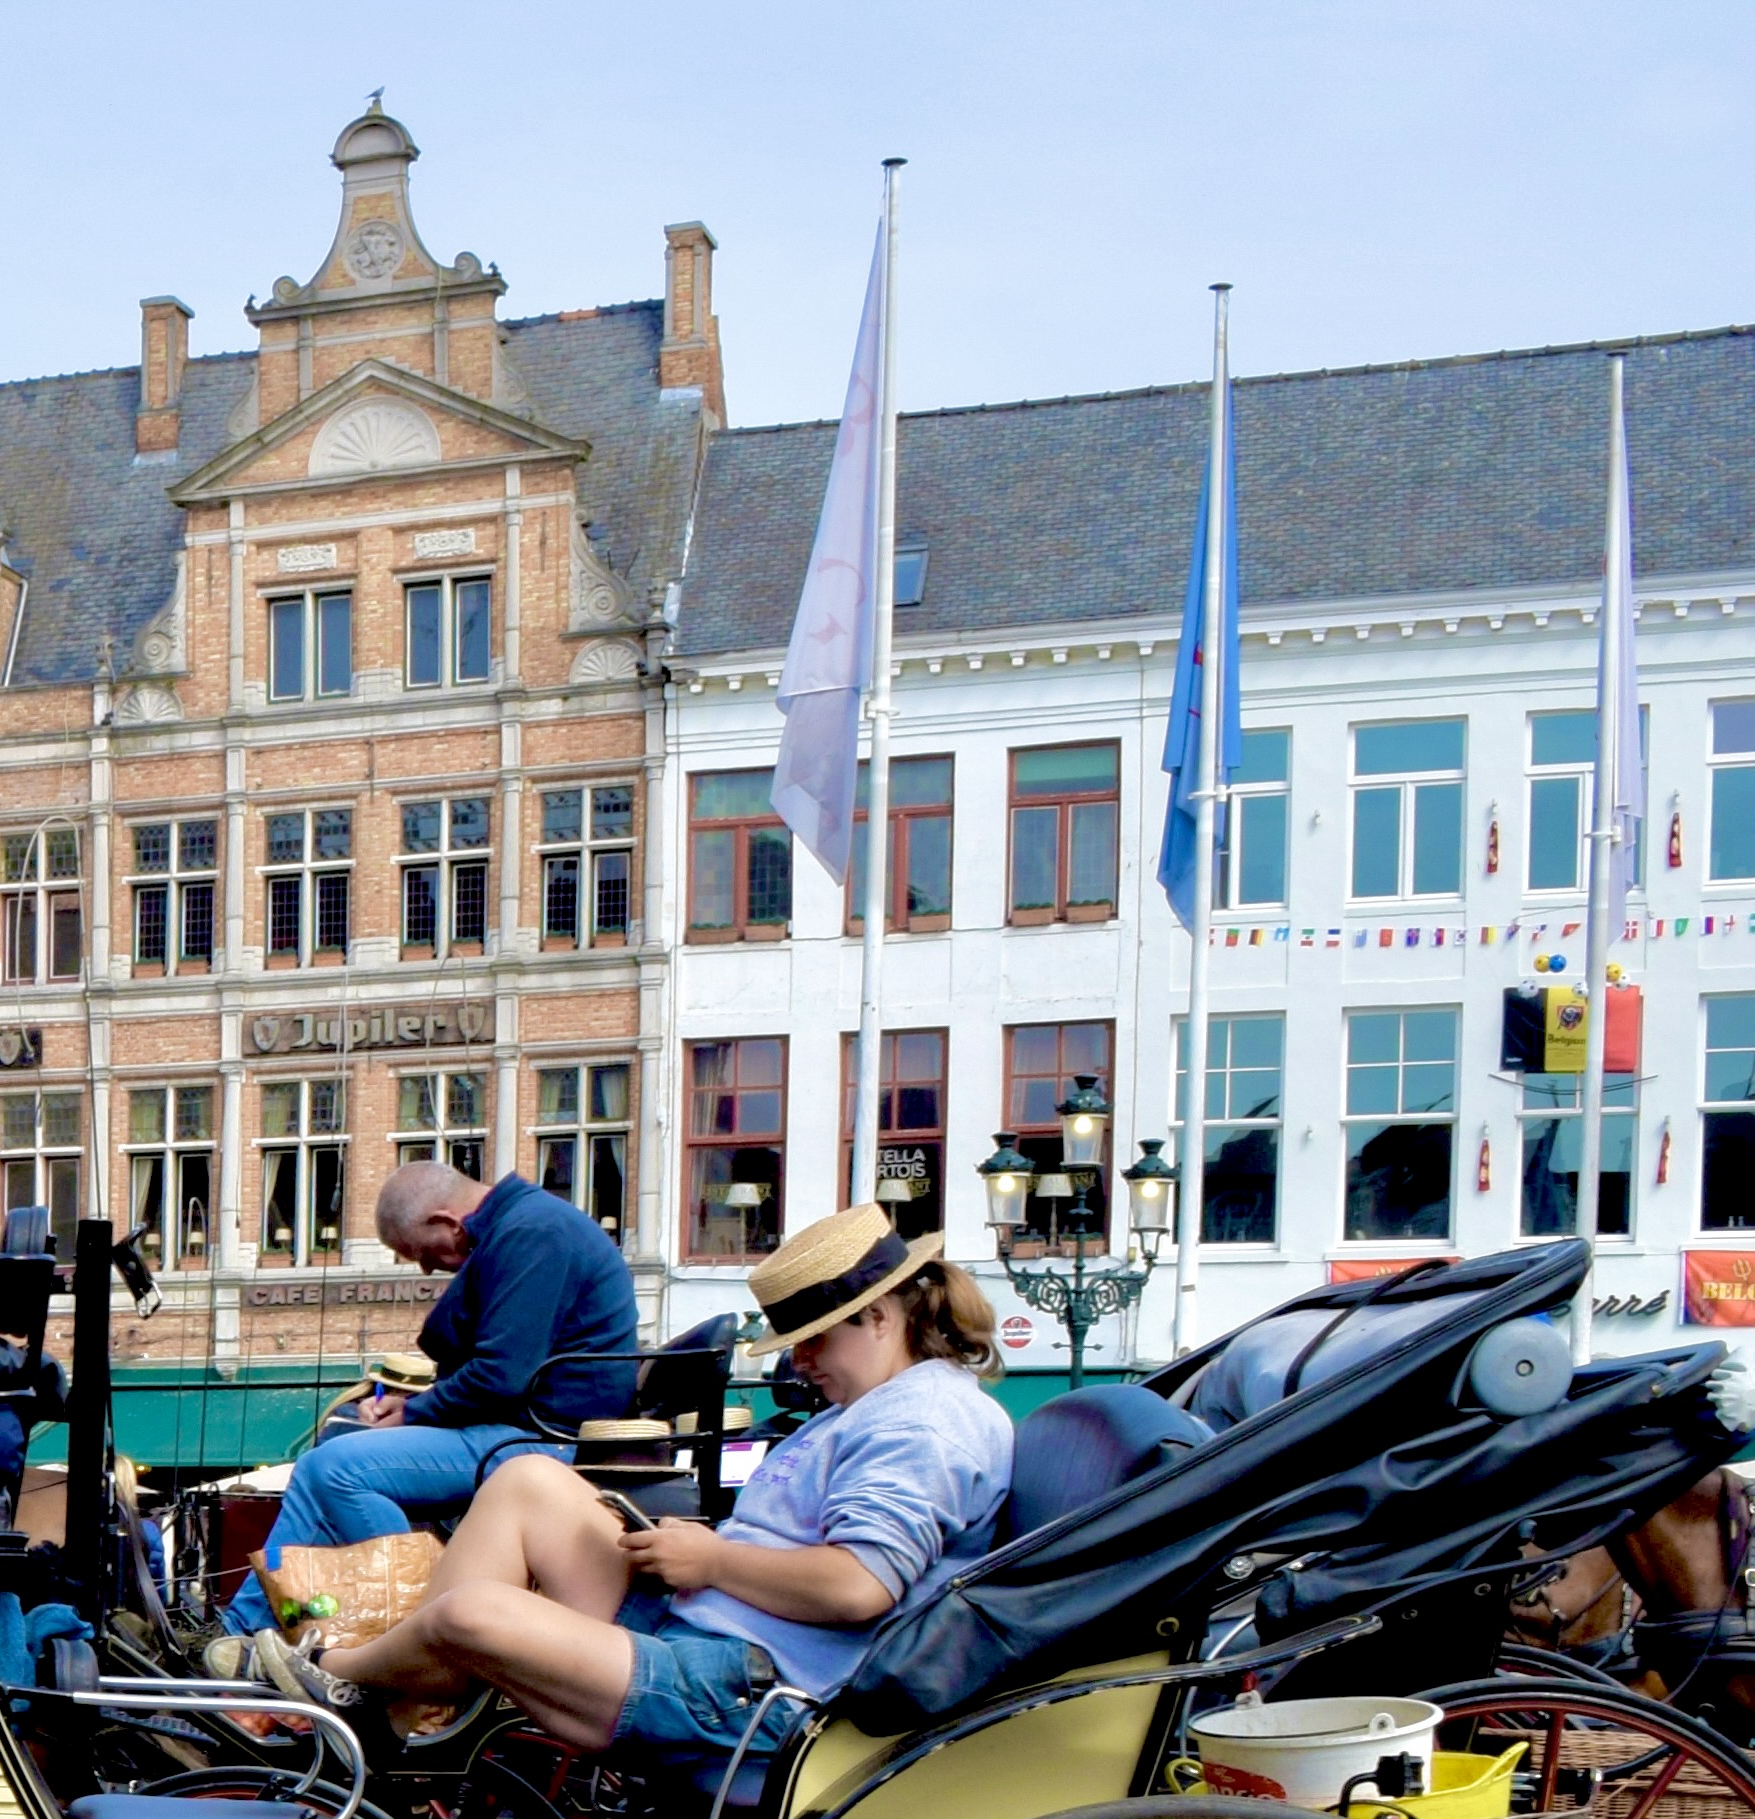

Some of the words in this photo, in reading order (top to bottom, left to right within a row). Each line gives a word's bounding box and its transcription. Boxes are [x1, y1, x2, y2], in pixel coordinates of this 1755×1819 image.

[290, 1009, 447, 1051] Jupiler
[876, 1148, 927, 1164] TELLA
[876, 1162, 927, 1178] RTOIS
[248, 1285, 323, 1306] CAFE
